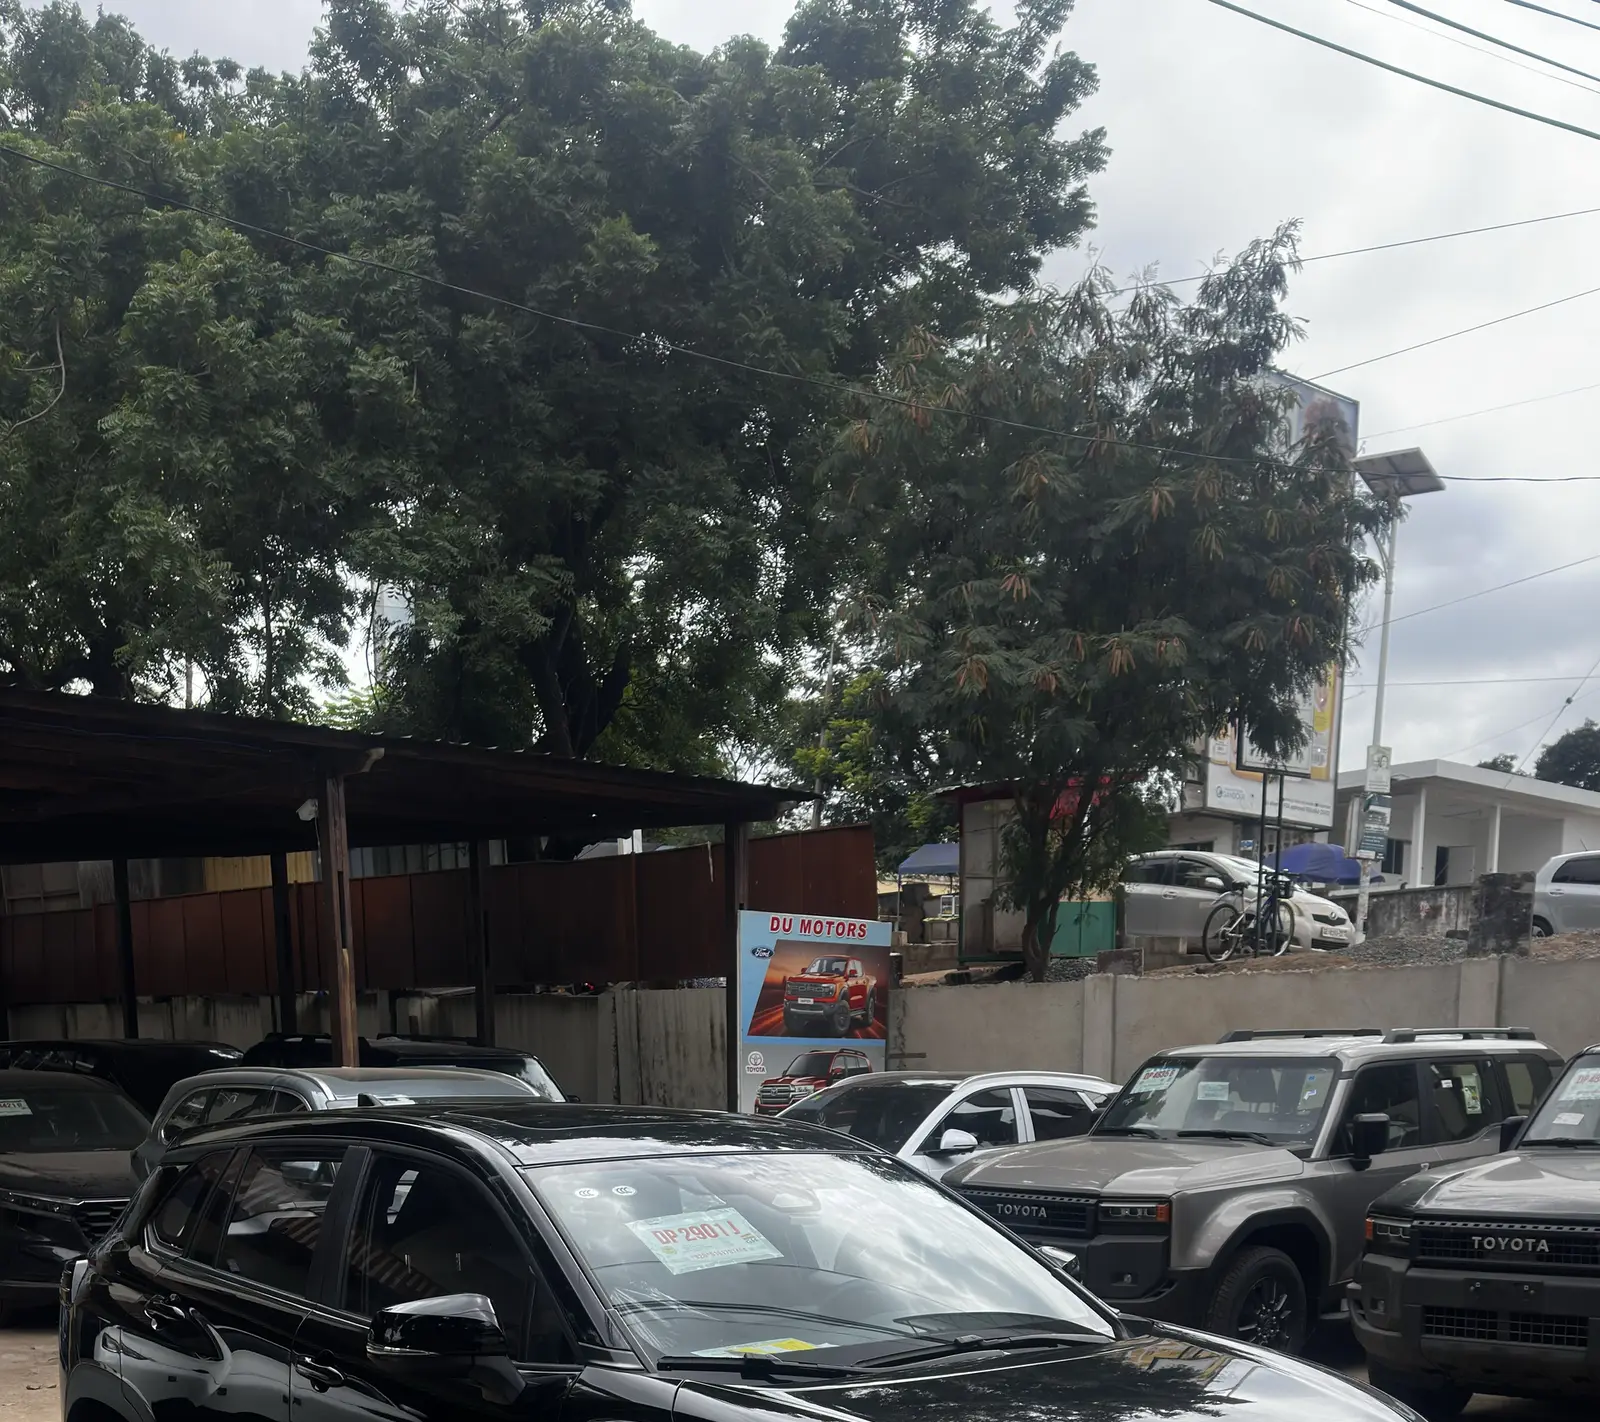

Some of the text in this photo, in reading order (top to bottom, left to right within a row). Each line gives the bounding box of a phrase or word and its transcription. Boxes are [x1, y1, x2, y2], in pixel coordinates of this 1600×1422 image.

[769, 916, 868, 938] DU MOTORS
[996, 1203, 1047, 1218] TOYOTA
[651, 1228, 679, 1245] DP
[677, 1222, 729, 1242] 2901
[1471, 1236, 1550, 1252] TOYOTA
